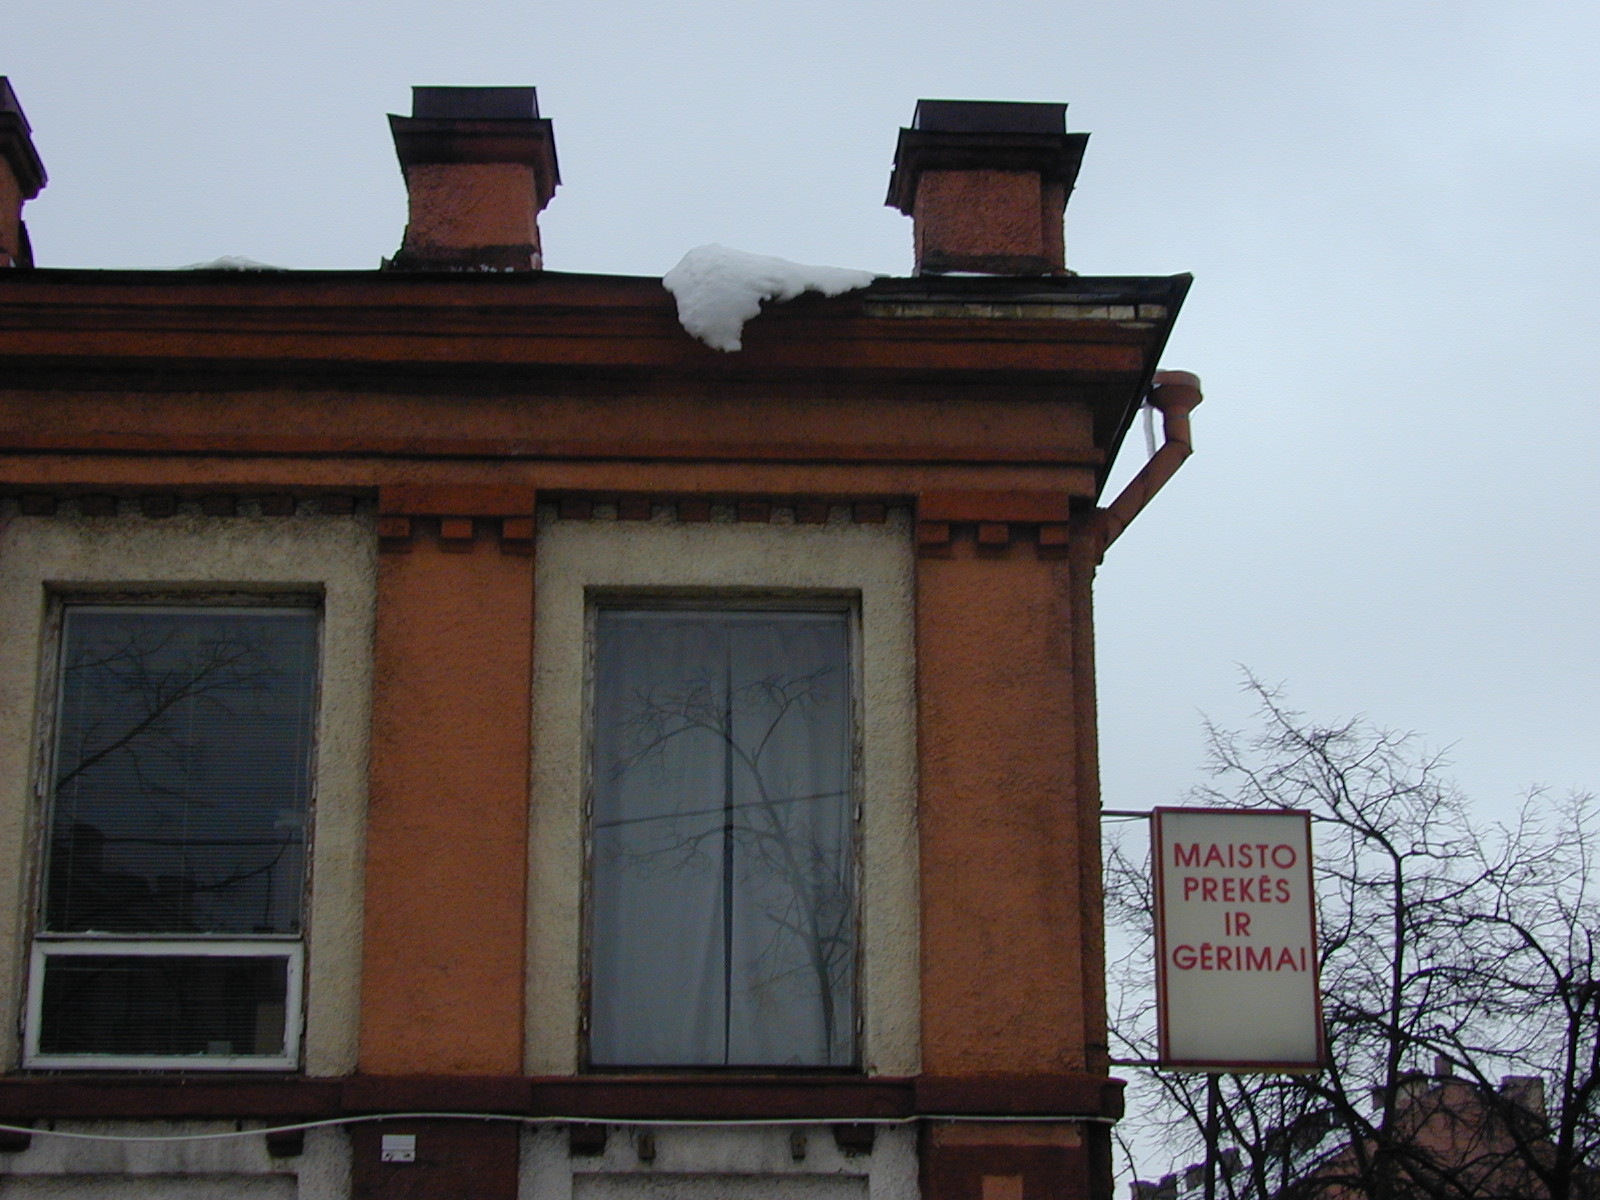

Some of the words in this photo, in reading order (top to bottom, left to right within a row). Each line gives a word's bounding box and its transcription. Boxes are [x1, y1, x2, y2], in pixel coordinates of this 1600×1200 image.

[1174, 843, 1297, 869] MAISTO
[1184, 875, 1291, 903] PREKĖS
[1225, 911, 1251, 936] IR
[1173, 942, 1307, 972] GĖRIMAI
